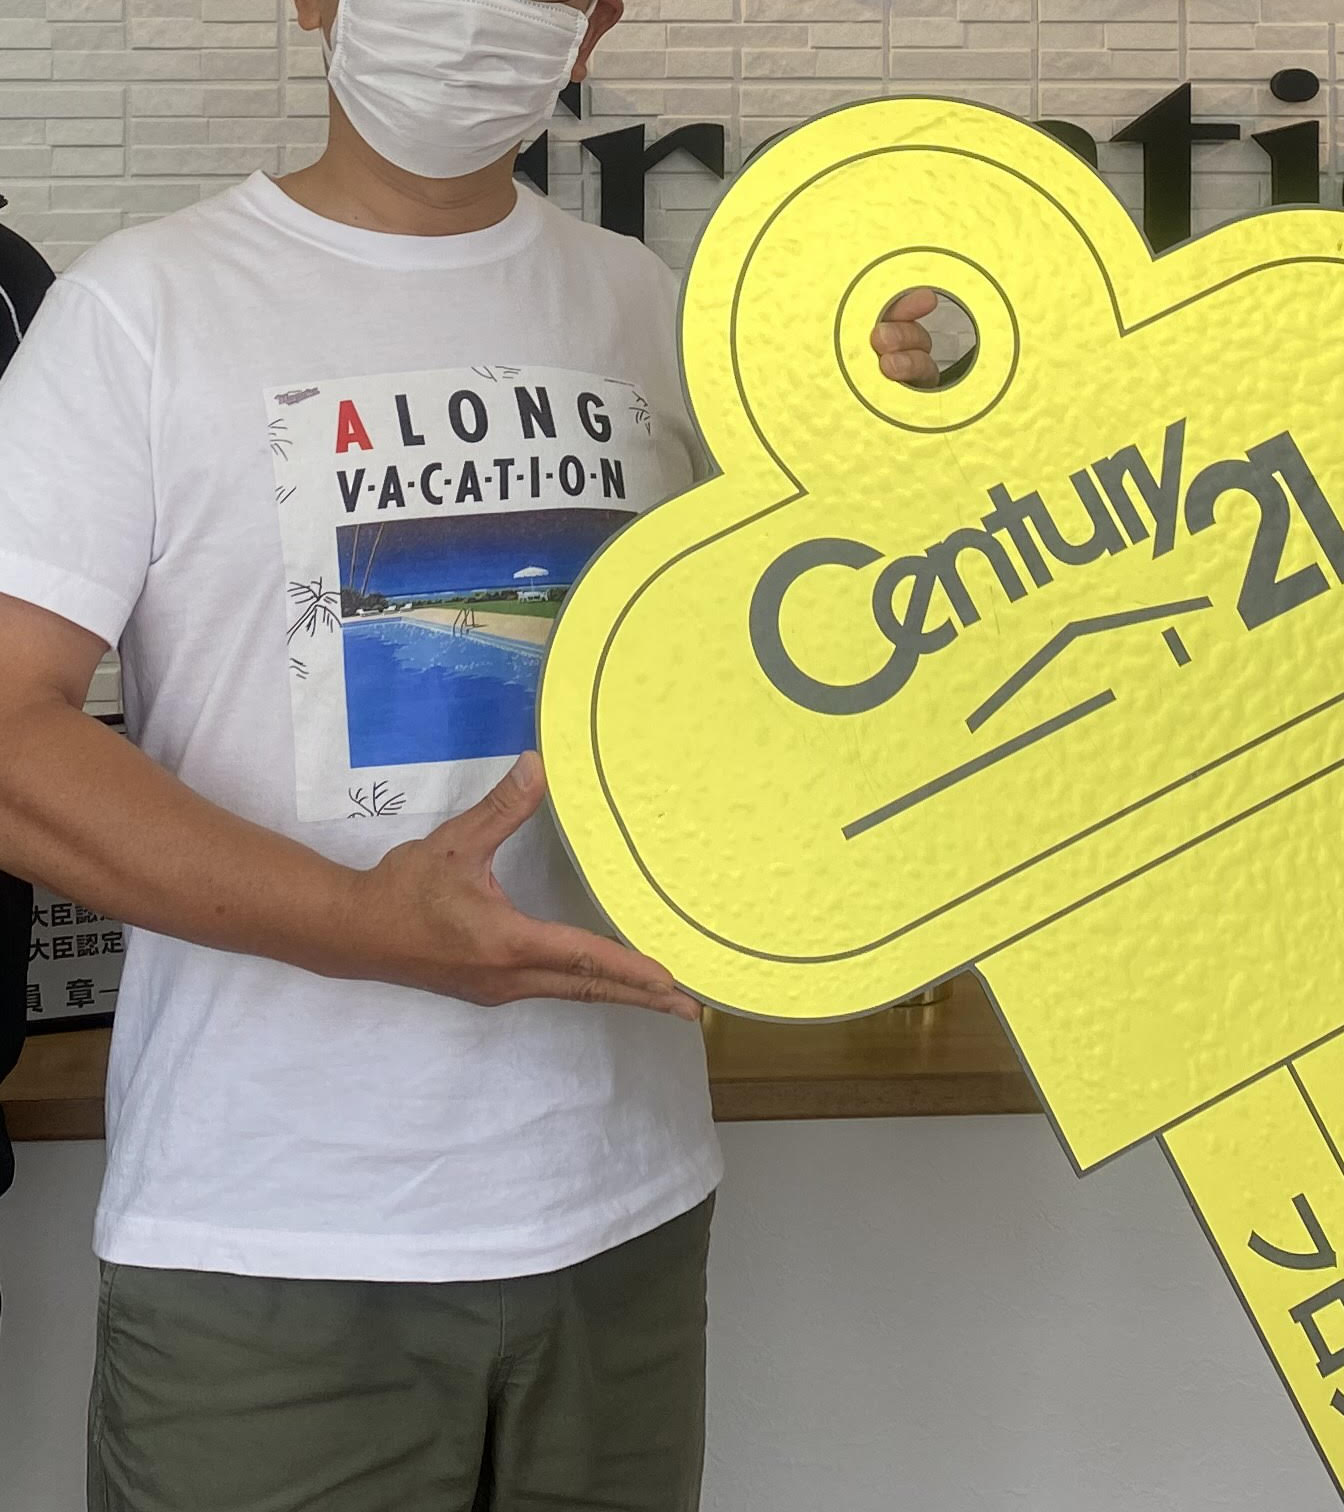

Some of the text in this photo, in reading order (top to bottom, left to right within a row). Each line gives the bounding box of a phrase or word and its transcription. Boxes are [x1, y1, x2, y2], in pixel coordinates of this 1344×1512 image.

[749, 417, 1188, 715] Century
[32, 902, 105, 927] 大臣認
